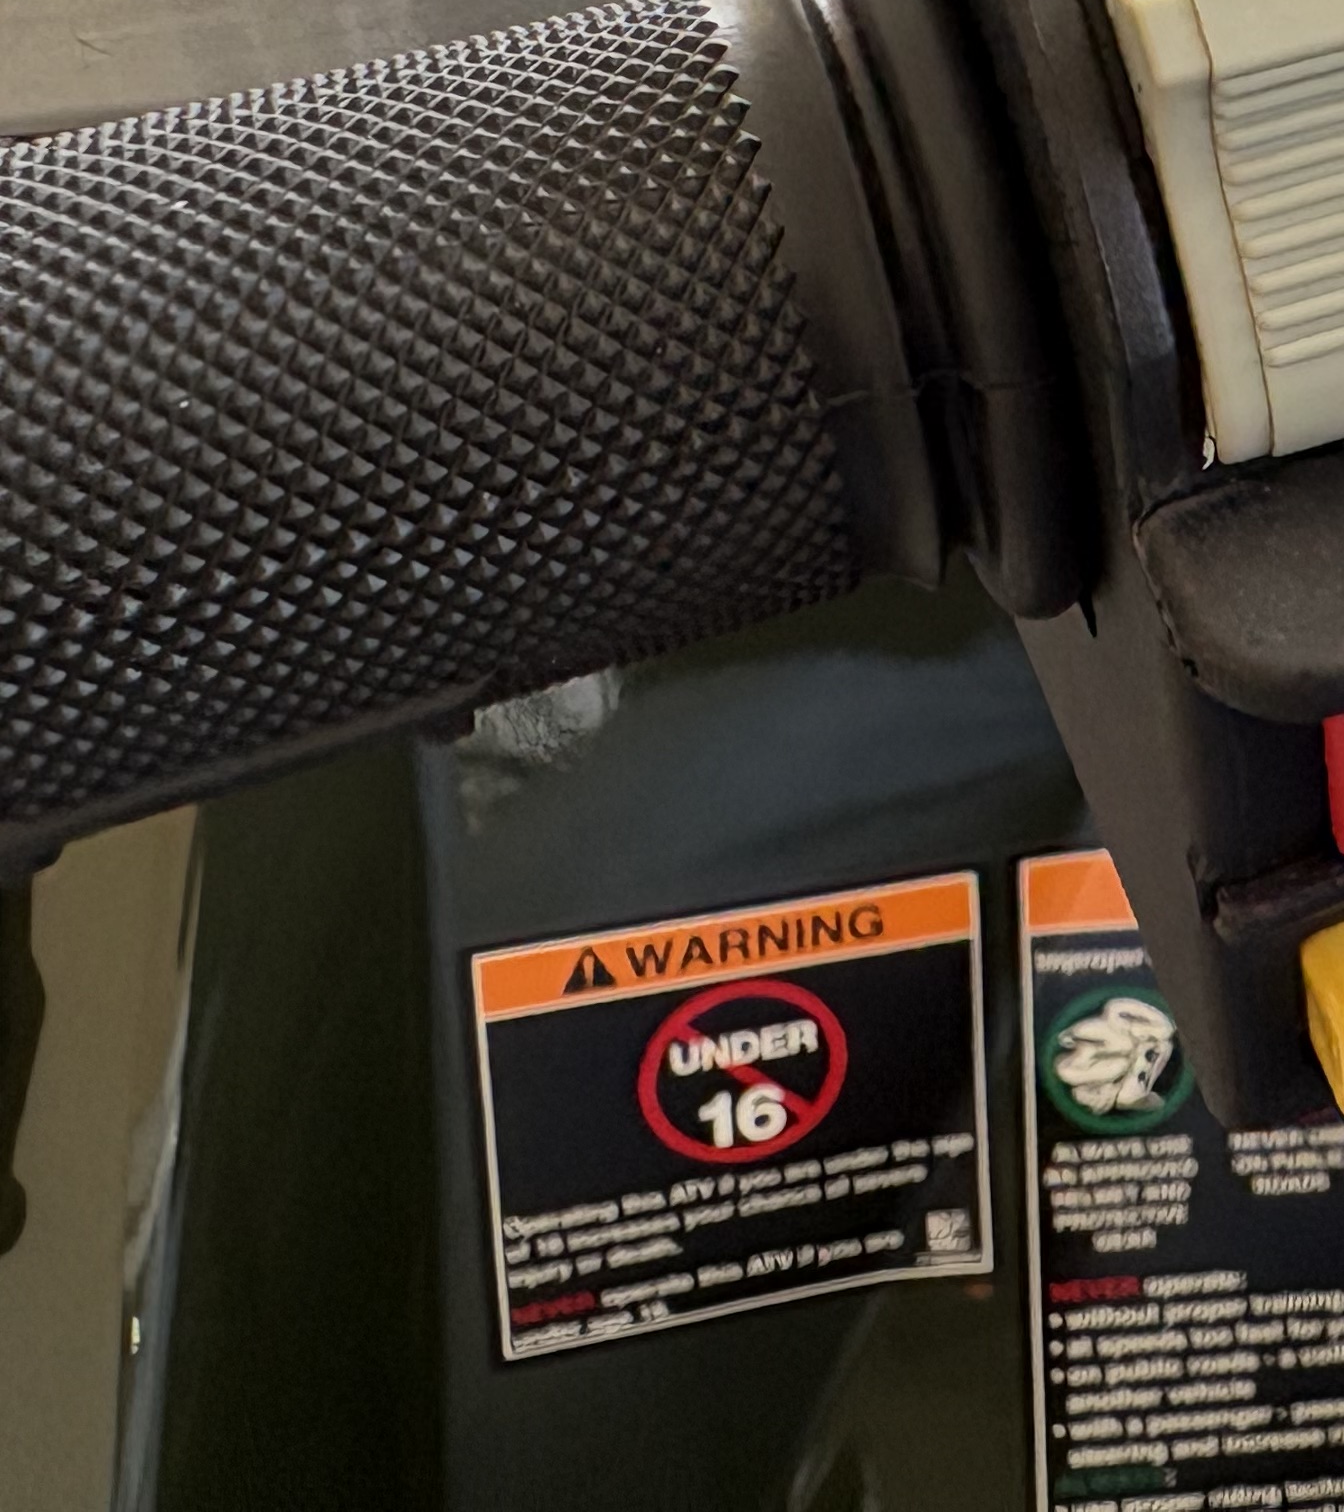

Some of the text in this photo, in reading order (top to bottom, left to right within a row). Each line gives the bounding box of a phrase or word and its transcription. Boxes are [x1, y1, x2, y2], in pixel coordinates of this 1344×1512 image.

[626, 903, 884, 979] WARNING
[668, 1018, 820, 1077] UNDER
[698, 1082, 788, 1149] 16
